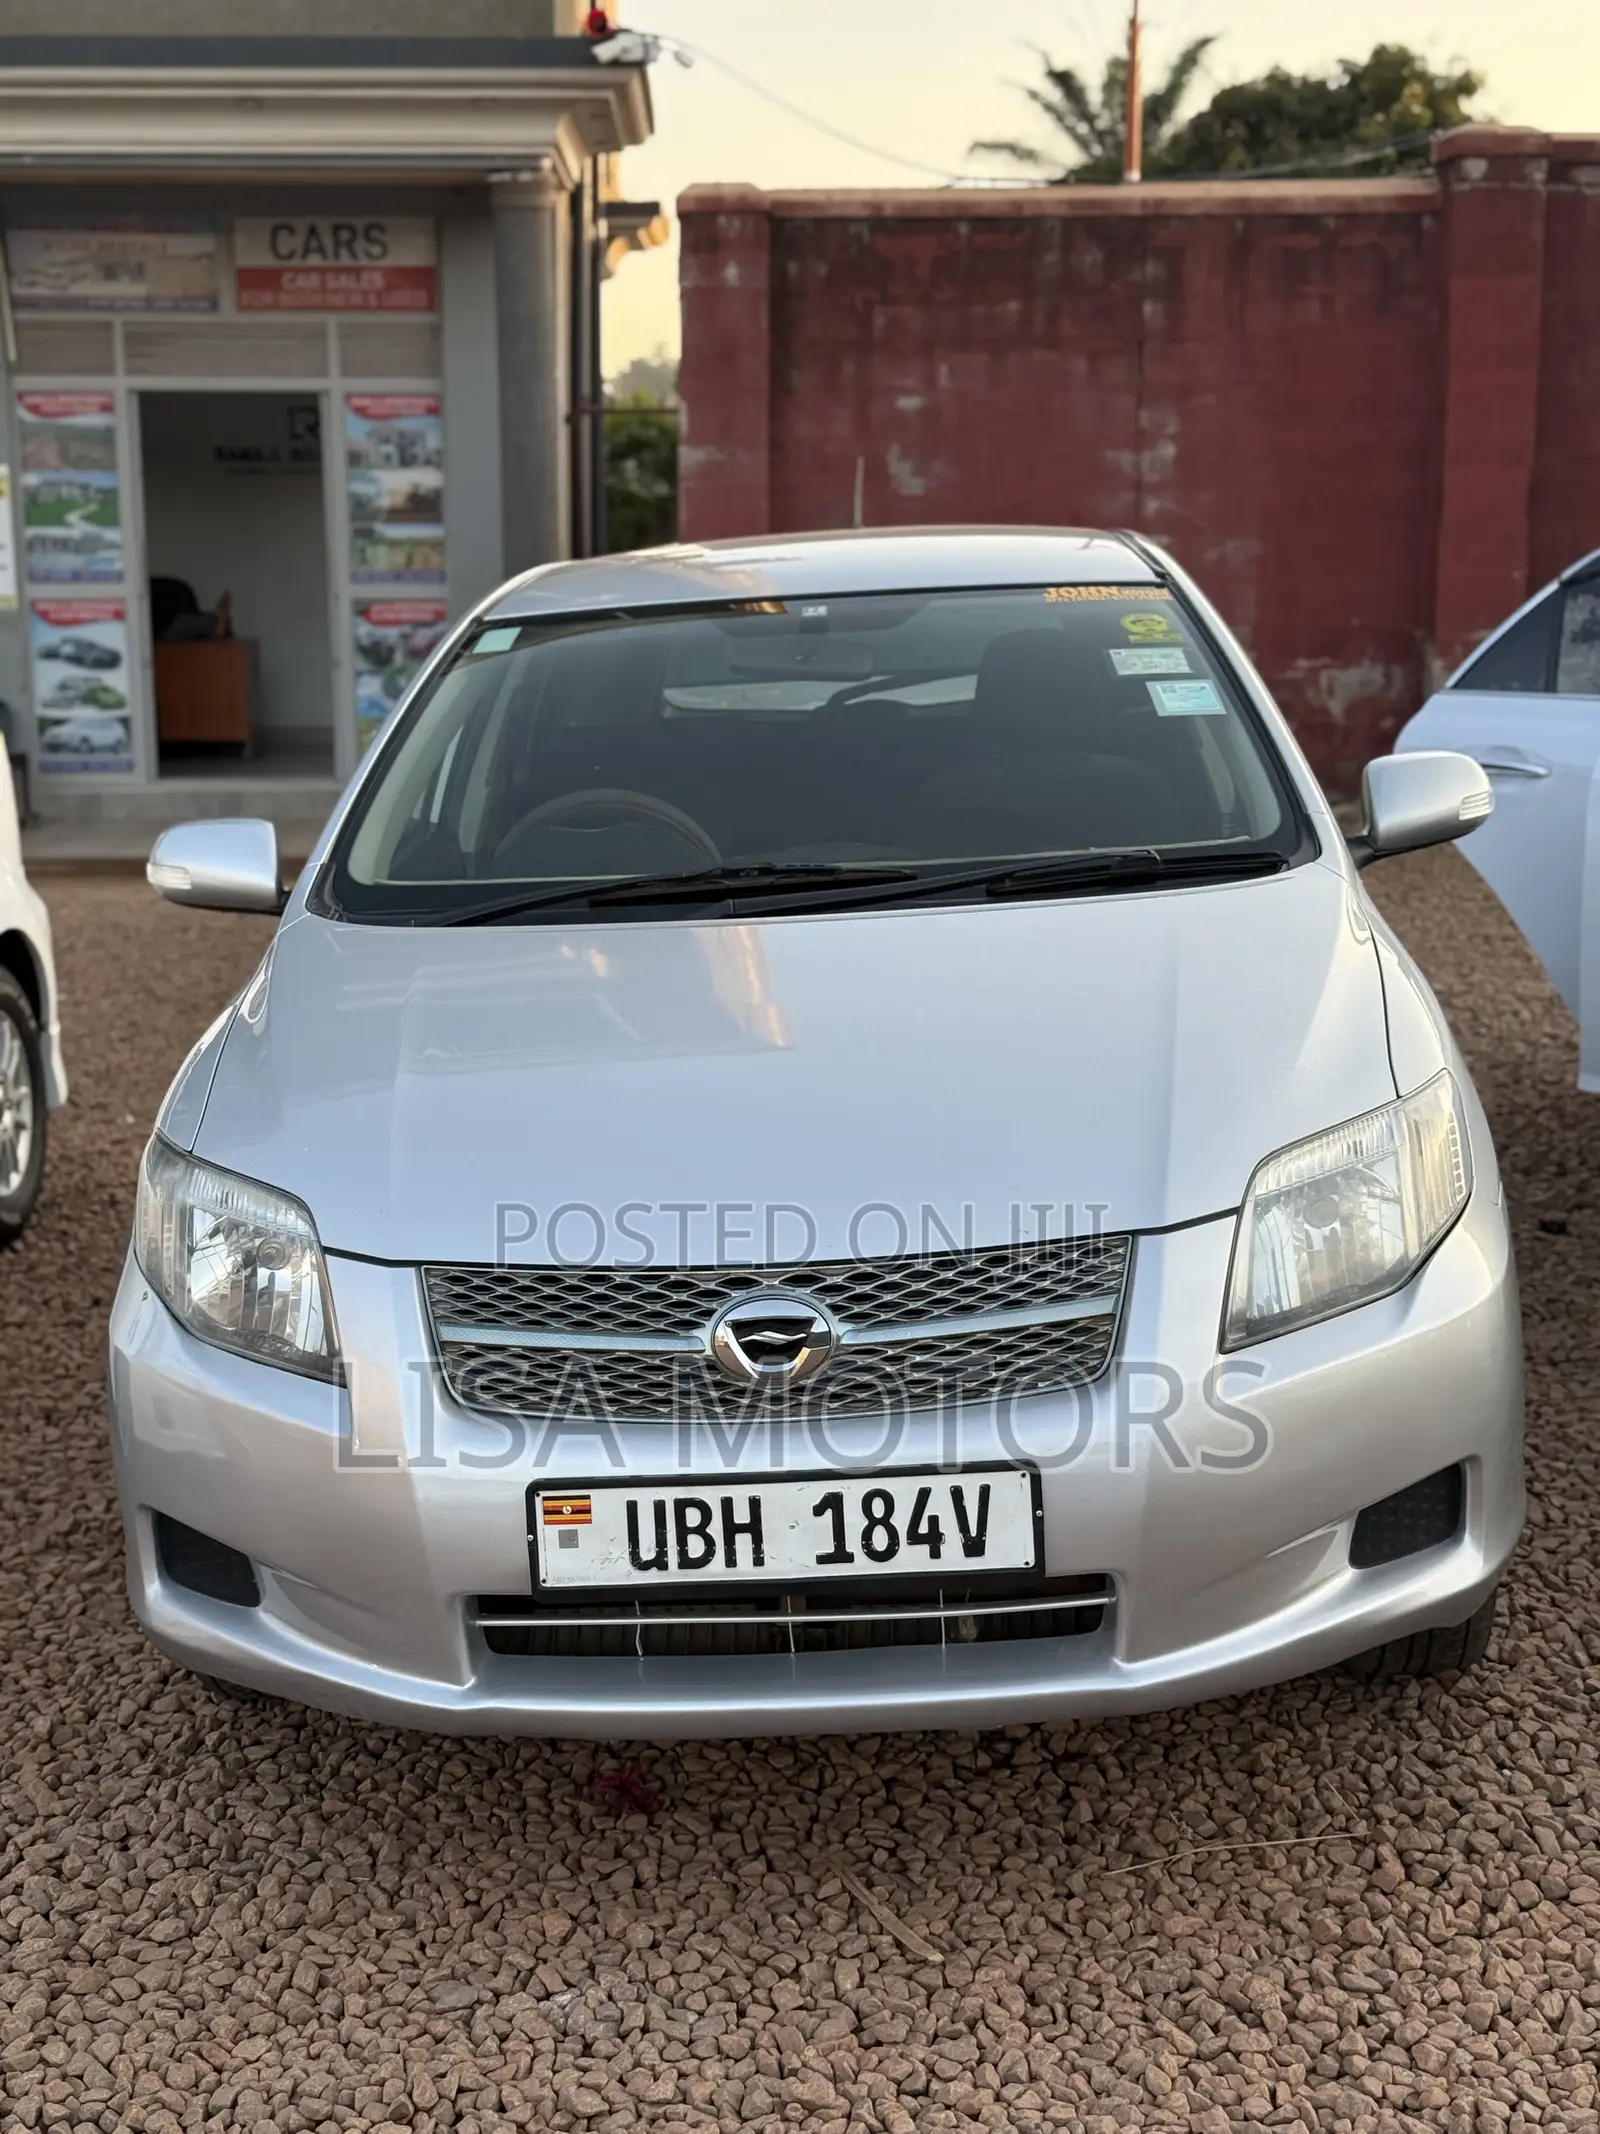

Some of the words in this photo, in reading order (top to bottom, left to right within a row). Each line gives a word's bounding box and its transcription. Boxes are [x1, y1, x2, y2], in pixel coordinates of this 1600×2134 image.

[270, 222, 389, 262] CARS
[626, 1495, 766, 1572] UBH
[812, 1483, 992, 1566] 184V
